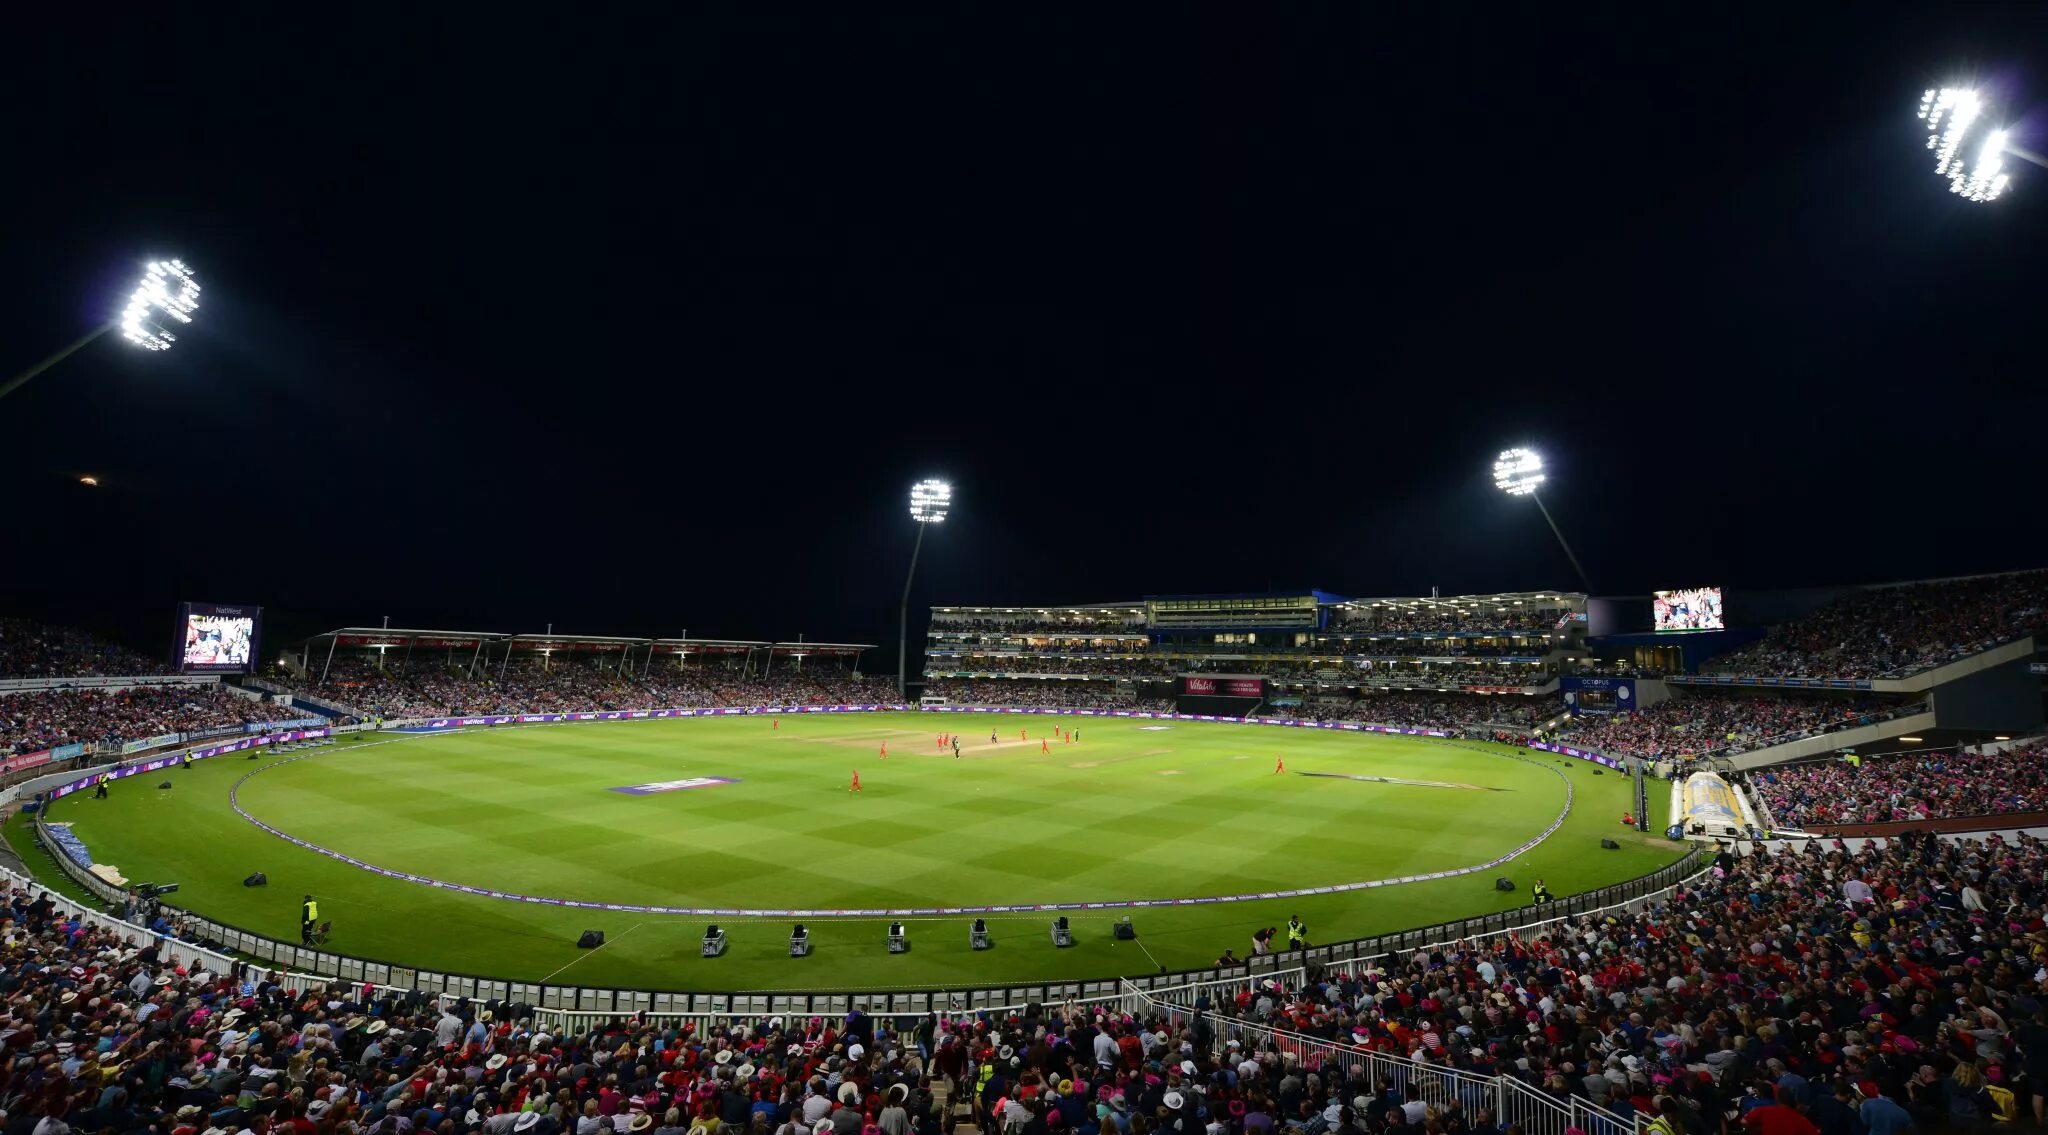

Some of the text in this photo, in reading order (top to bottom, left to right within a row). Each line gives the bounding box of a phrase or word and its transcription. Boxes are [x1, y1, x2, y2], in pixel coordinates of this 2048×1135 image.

[216, 607, 242, 615] NatWest
[1190, 679, 1216, 693] Vitality
[304, 729, 324, 738] NatWest
